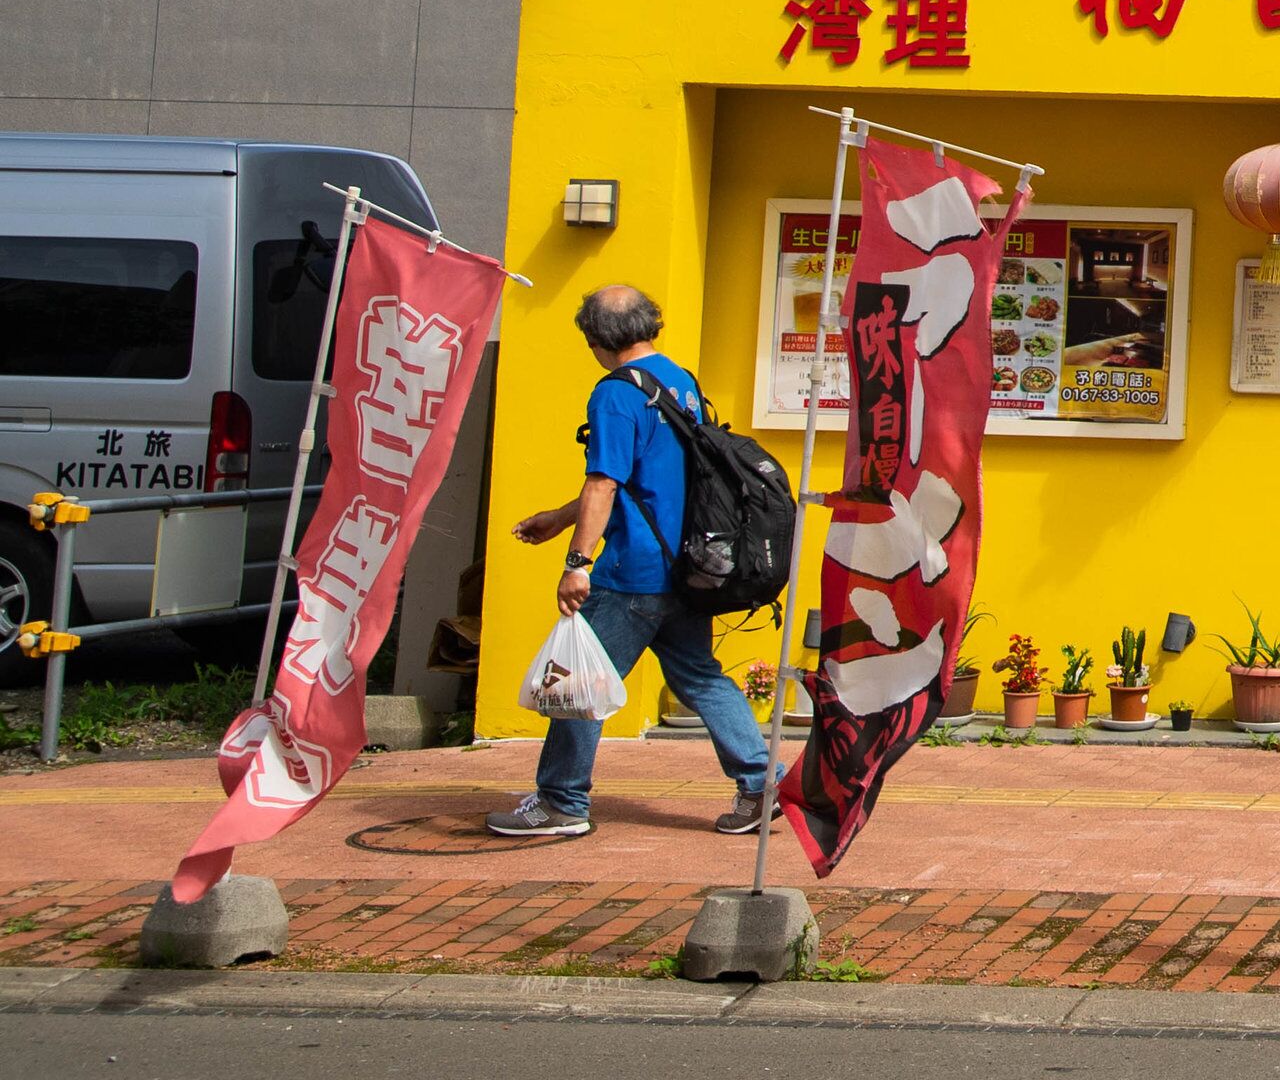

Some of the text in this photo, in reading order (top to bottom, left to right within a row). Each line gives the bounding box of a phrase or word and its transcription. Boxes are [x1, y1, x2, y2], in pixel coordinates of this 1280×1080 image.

[856, 293, 902, 491] 味自慢
[1061, 388, 1160, 404] 0167-33-1005
[56, 461, 204, 491] KITATABI
